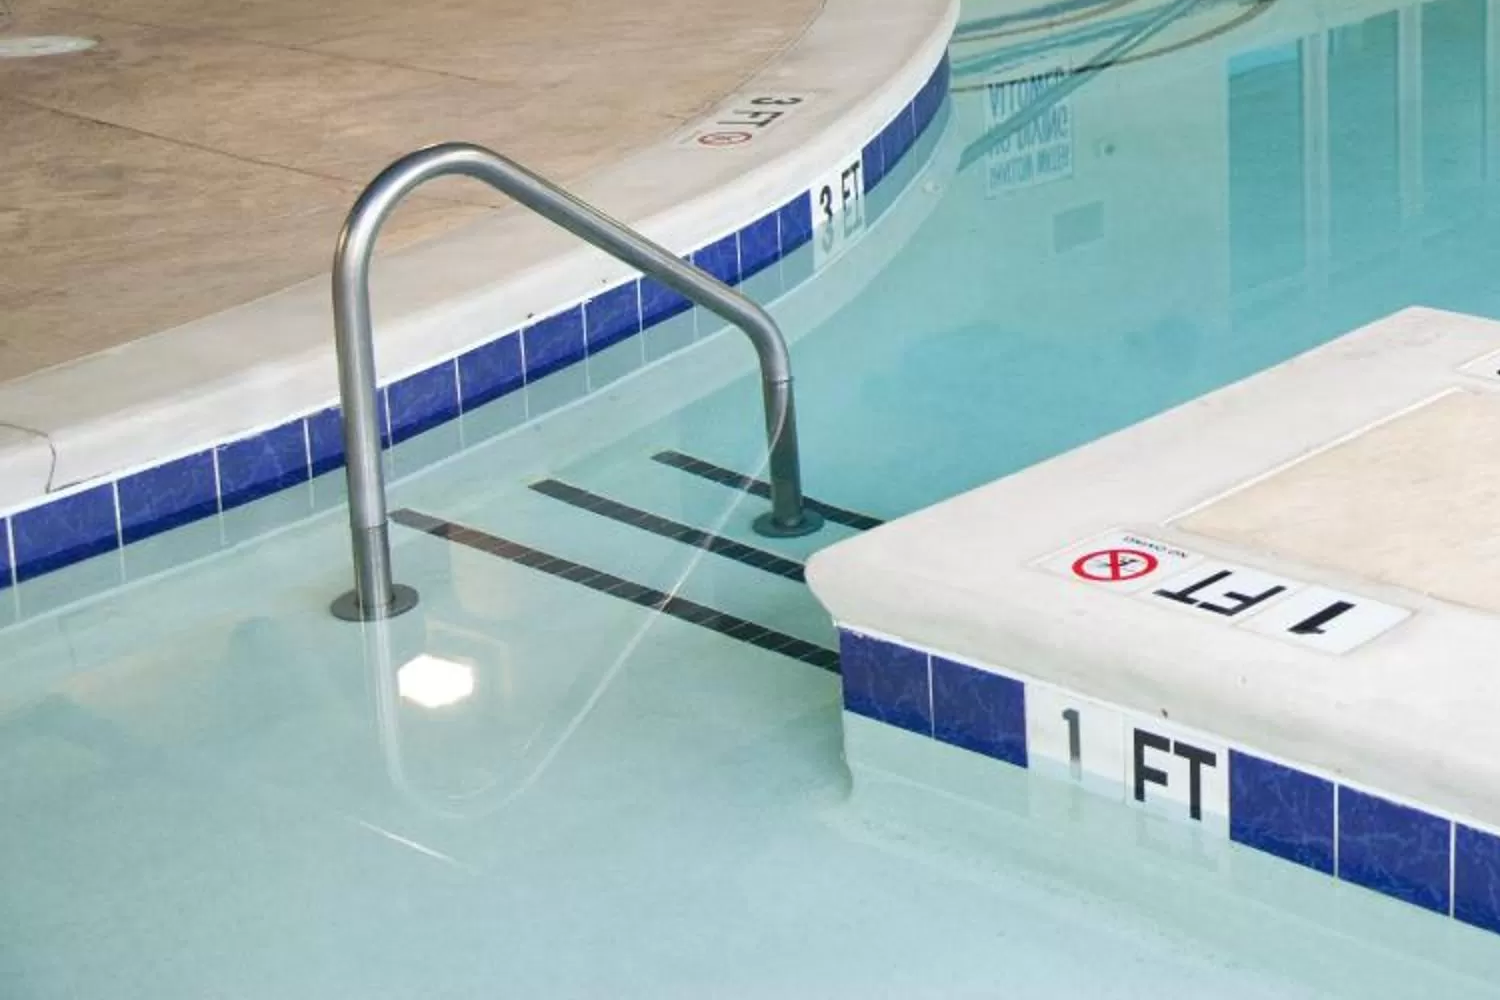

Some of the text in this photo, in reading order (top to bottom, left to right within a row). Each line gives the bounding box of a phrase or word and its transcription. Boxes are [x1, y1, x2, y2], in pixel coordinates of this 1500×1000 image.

[716, 97, 803, 128] 3 FT
[820, 160, 860, 223] 3 FT
[1153, 569, 1357, 636] 1 FT
[1061, 708, 1217, 822] 1 FT
